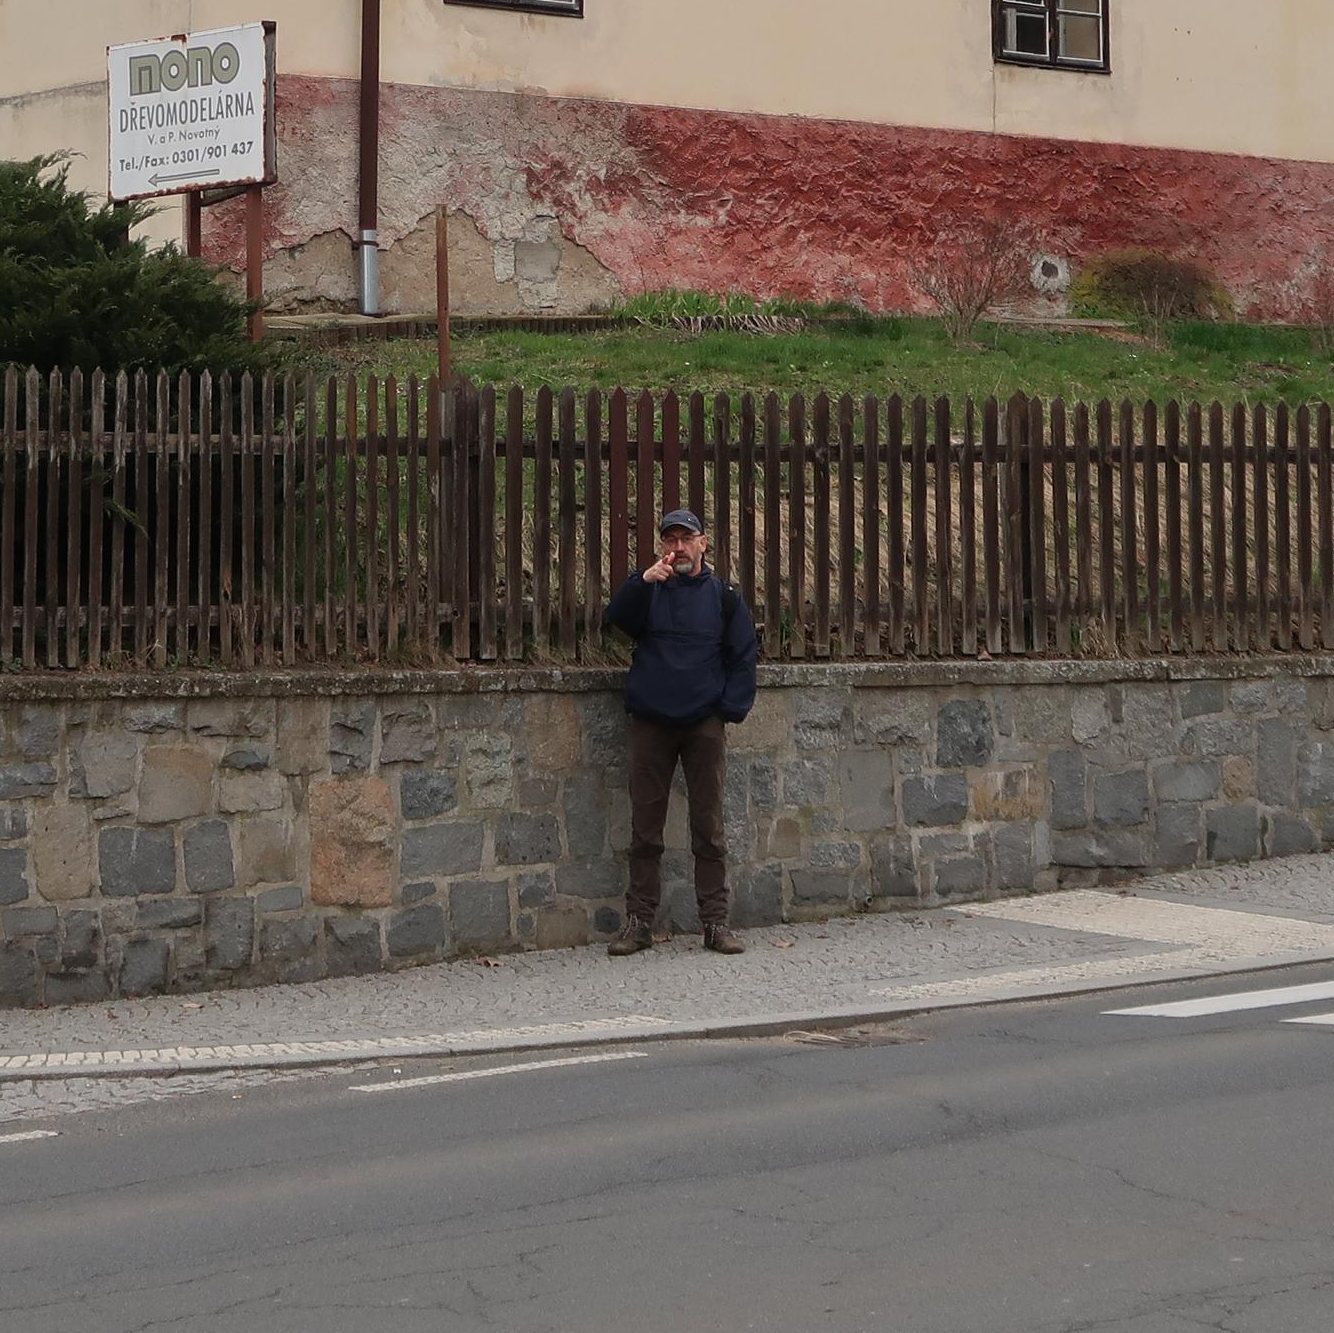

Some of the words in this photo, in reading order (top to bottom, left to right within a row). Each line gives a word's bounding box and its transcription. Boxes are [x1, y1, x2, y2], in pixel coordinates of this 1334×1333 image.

[119, 90, 255, 133] DŘEVOMODELÁRNA
[147, 134, 157, 145] V.
[159, 136, 166, 144] a
[168, 131, 177, 143] P.
[119, 154, 170, 172] Tel./Fax:
[172, 145, 227, 164] 0301/901
[231, 141, 253, 155] 437
